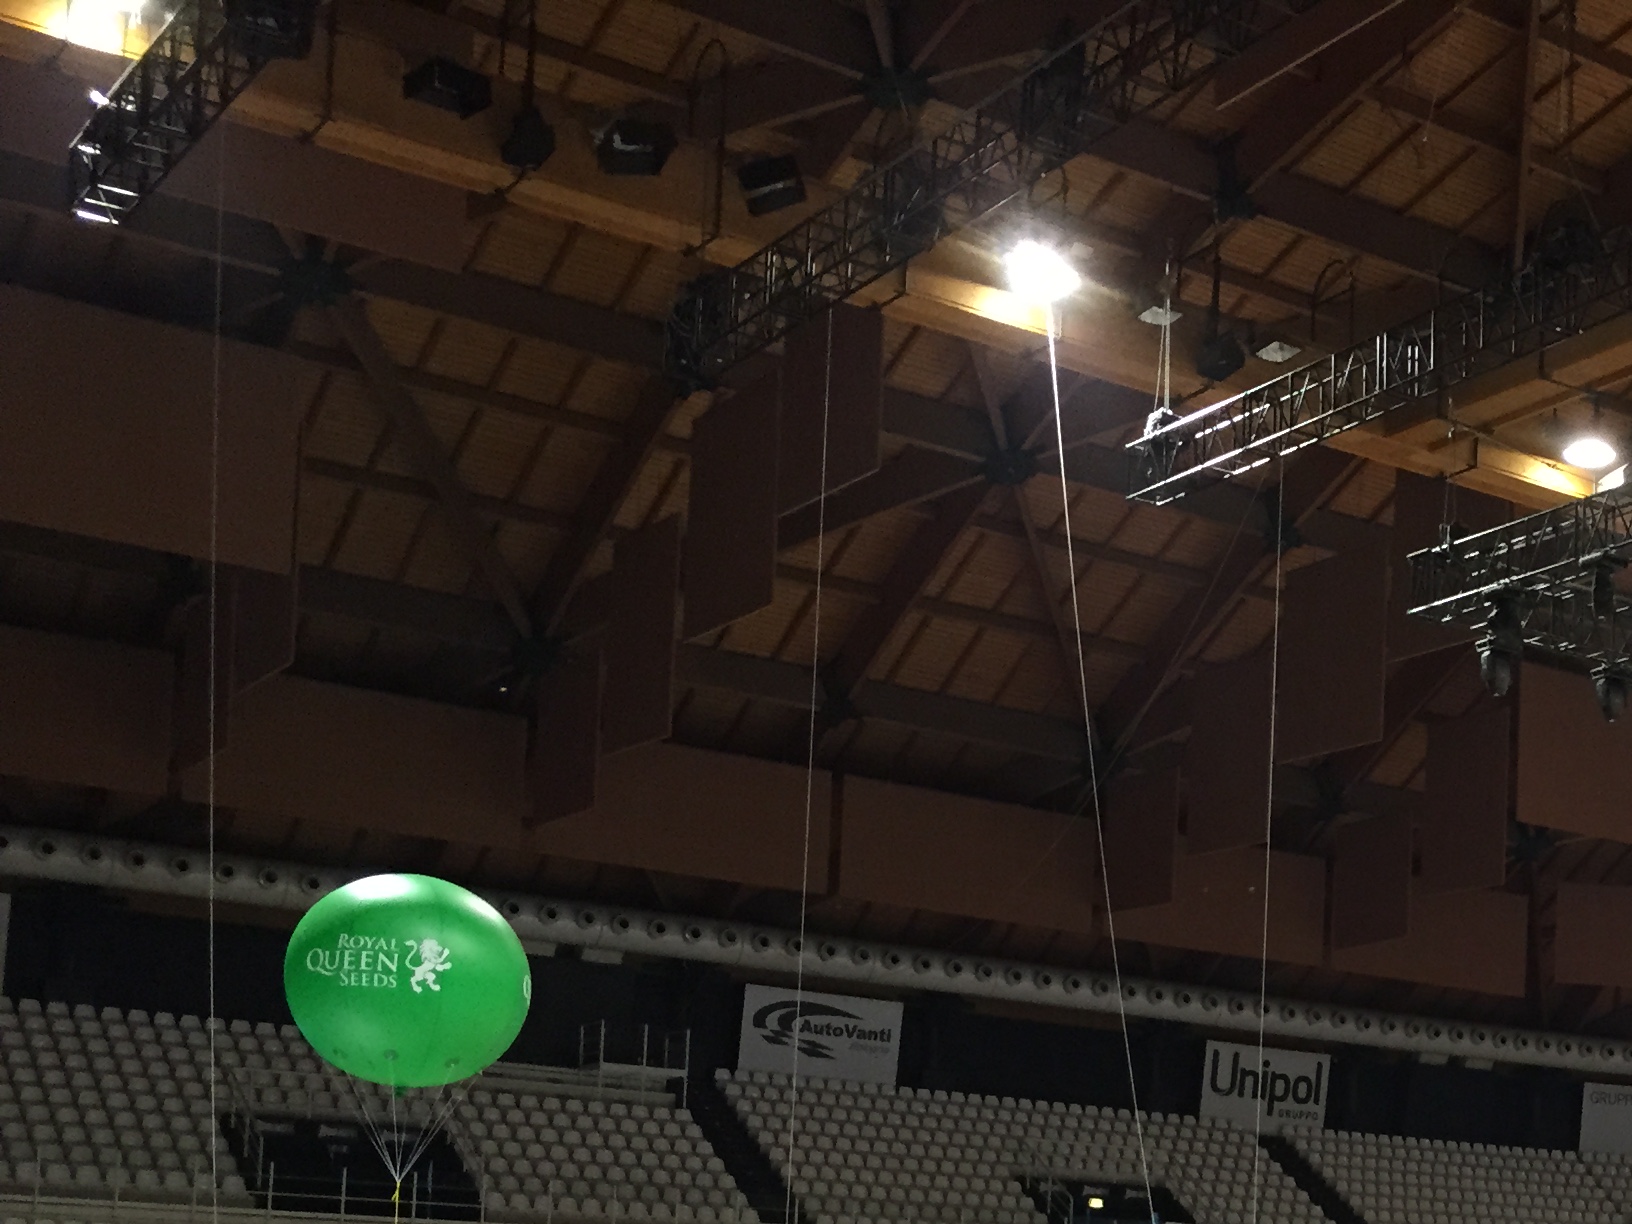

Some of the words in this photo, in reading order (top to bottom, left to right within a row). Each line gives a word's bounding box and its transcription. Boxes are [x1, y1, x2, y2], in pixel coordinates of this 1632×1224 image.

[338, 933, 399, 950] ROYAL
[306, 948, 398, 976] QUEEN
[339, 972, 398, 988] SEEDS
[800, 1019, 891, 1043] AutoVanti
[1209, 1049, 1323, 1116] Unipol
